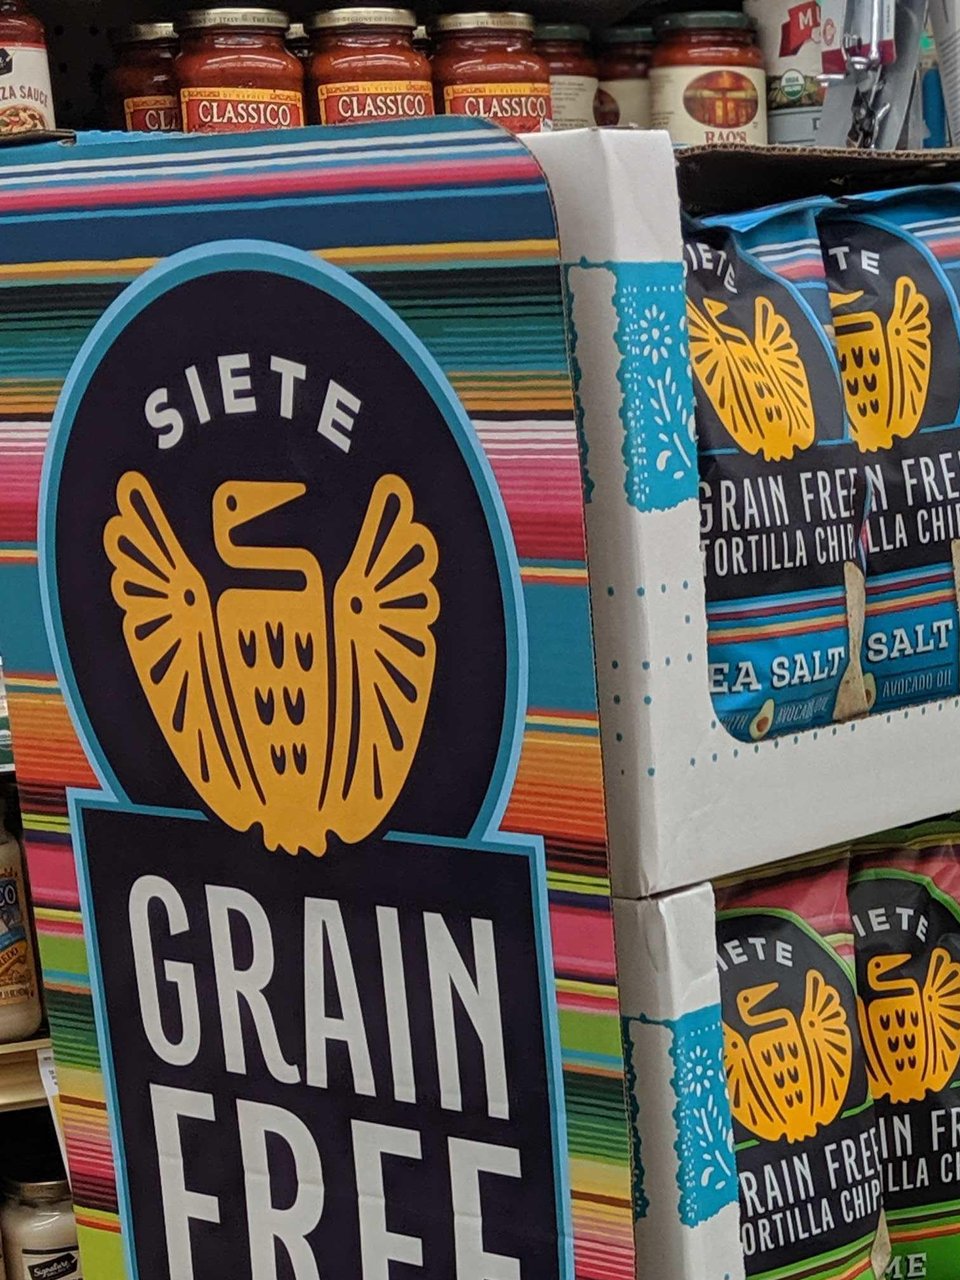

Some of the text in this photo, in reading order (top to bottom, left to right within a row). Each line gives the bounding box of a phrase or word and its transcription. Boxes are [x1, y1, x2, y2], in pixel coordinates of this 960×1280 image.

[198, 100, 291, 126] CLASSICO
[338, 95, 426, 117] CLASSICO
[464, 96, 548, 118] CLASSICO
[704, 130, 747, 144] RAO'S
[686, 242, 739, 294] IETE
[144, 352, 362, 455] SIETE
[815, 523, 857, 565] CHIP
[867, 618, 954, 662] SALT
[709, 646, 846, 694] EA SALT
[883, 675, 933, 698] AVOCADO
[854, 905, 930, 943] IETE
[717, 936, 794, 971] IETE
[128, 874, 510, 1121] GRAIN
[739, 1152, 815, 1218] RAIN
[741, 1178, 882, 1257] ORTILLA CHIP
[885, 1252, 928, 1280] ME
